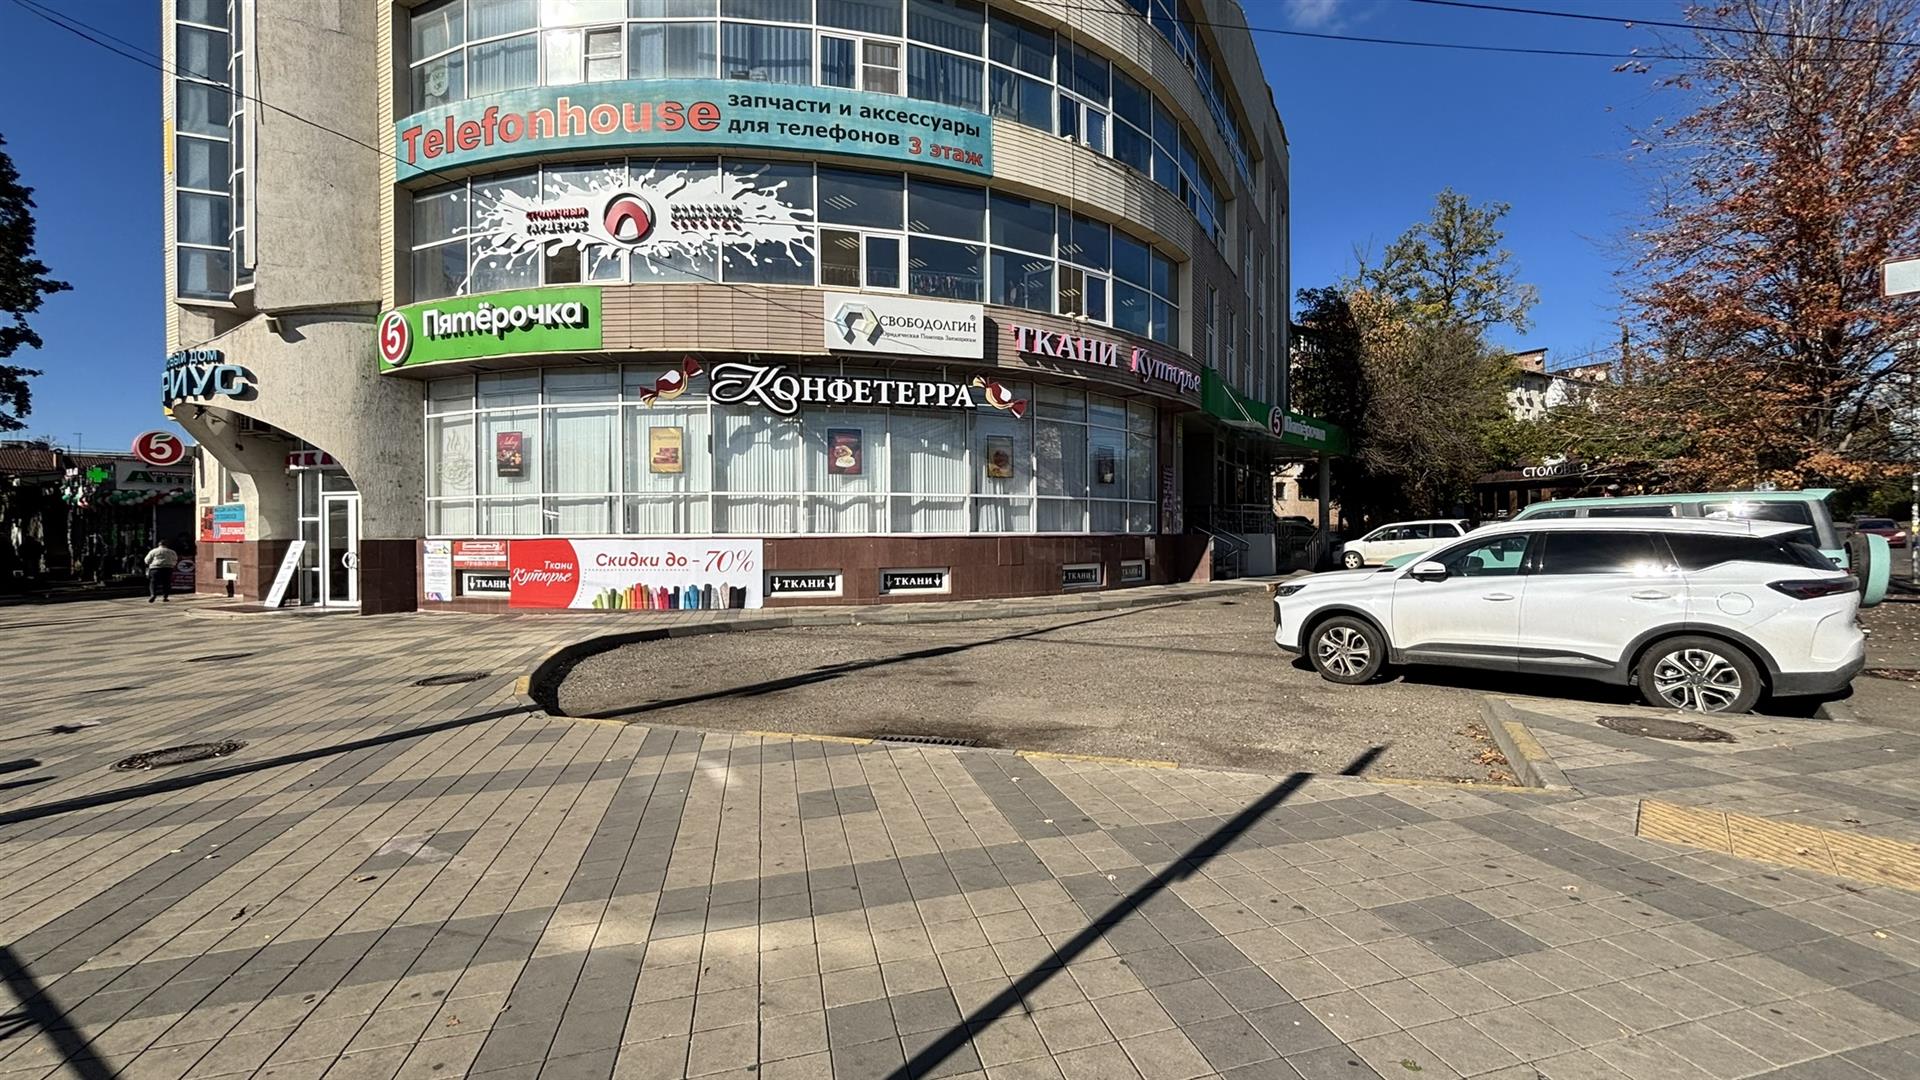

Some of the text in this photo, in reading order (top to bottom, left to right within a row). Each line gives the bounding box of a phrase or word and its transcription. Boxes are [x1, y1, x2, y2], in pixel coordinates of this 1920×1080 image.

[728, 94, 980, 138] запчасти и аксессуары
[402, 97, 721, 166] Telefonhouse
[728, 119, 984, 167] для телефонов 3 этаж
[422, 302, 581, 336] Пятёрочка
[879, 315, 977, 333] СВОБОДОЛГИН
[386, 312, 402, 354] 5
[189, 349, 218, 365] ДОМ
[1010, 324, 1200, 393] ТКАНИ Кутюрье
[149, 433, 173, 460] 5
[544, 560, 573, 570] Ткани
[596, 552, 660, 567] Скидки
[665, 551, 688, 567] до
[476, 579, 507, 589] ТКАНИ
[512, 568, 573, 586] Кутюрье
[783, 579, 826, 589] ТКАНИ
[894, 577, 933, 586] ТКАНИ
[1067, 572, 1091, 580] ТКАНИ
